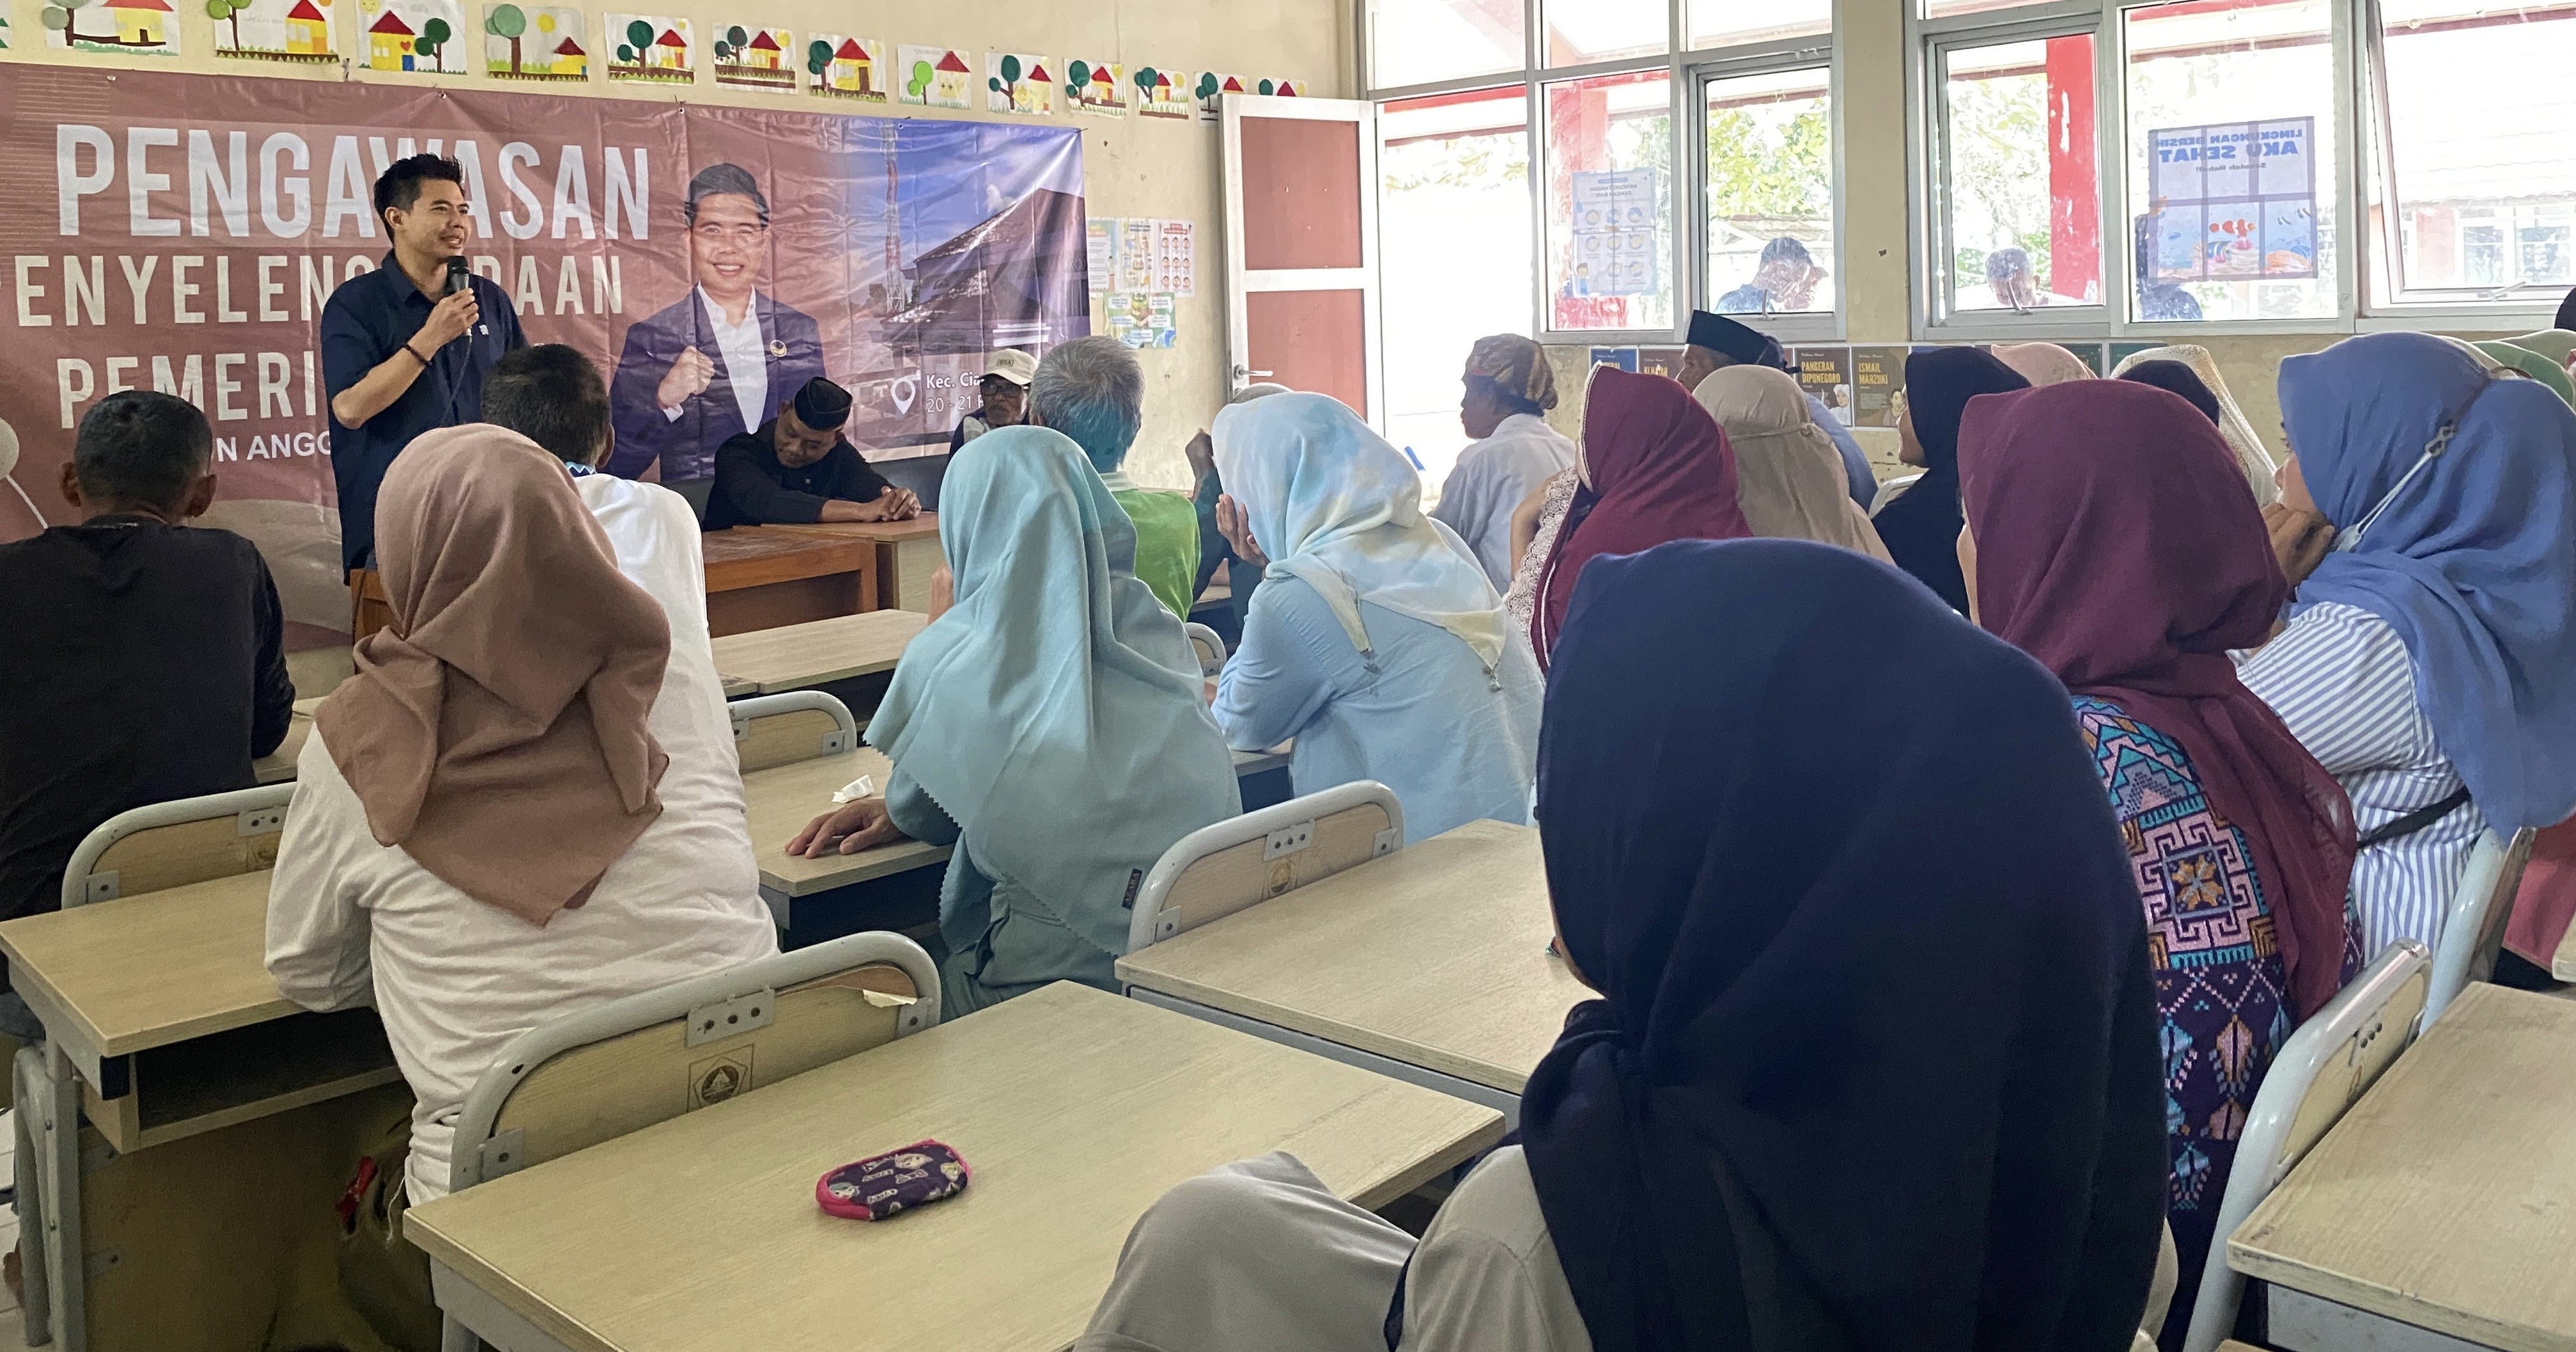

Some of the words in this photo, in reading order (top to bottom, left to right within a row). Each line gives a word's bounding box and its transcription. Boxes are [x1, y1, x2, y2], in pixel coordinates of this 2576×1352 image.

[57, 350, 316, 429] PEMERI
[926, 374, 955, 390] Kec.
[959, 371, 982, 387] Cia
[927, 398, 944, 413] 20
[958, 395, 972, 410] 21
[246, 430, 332, 460] ANGG
